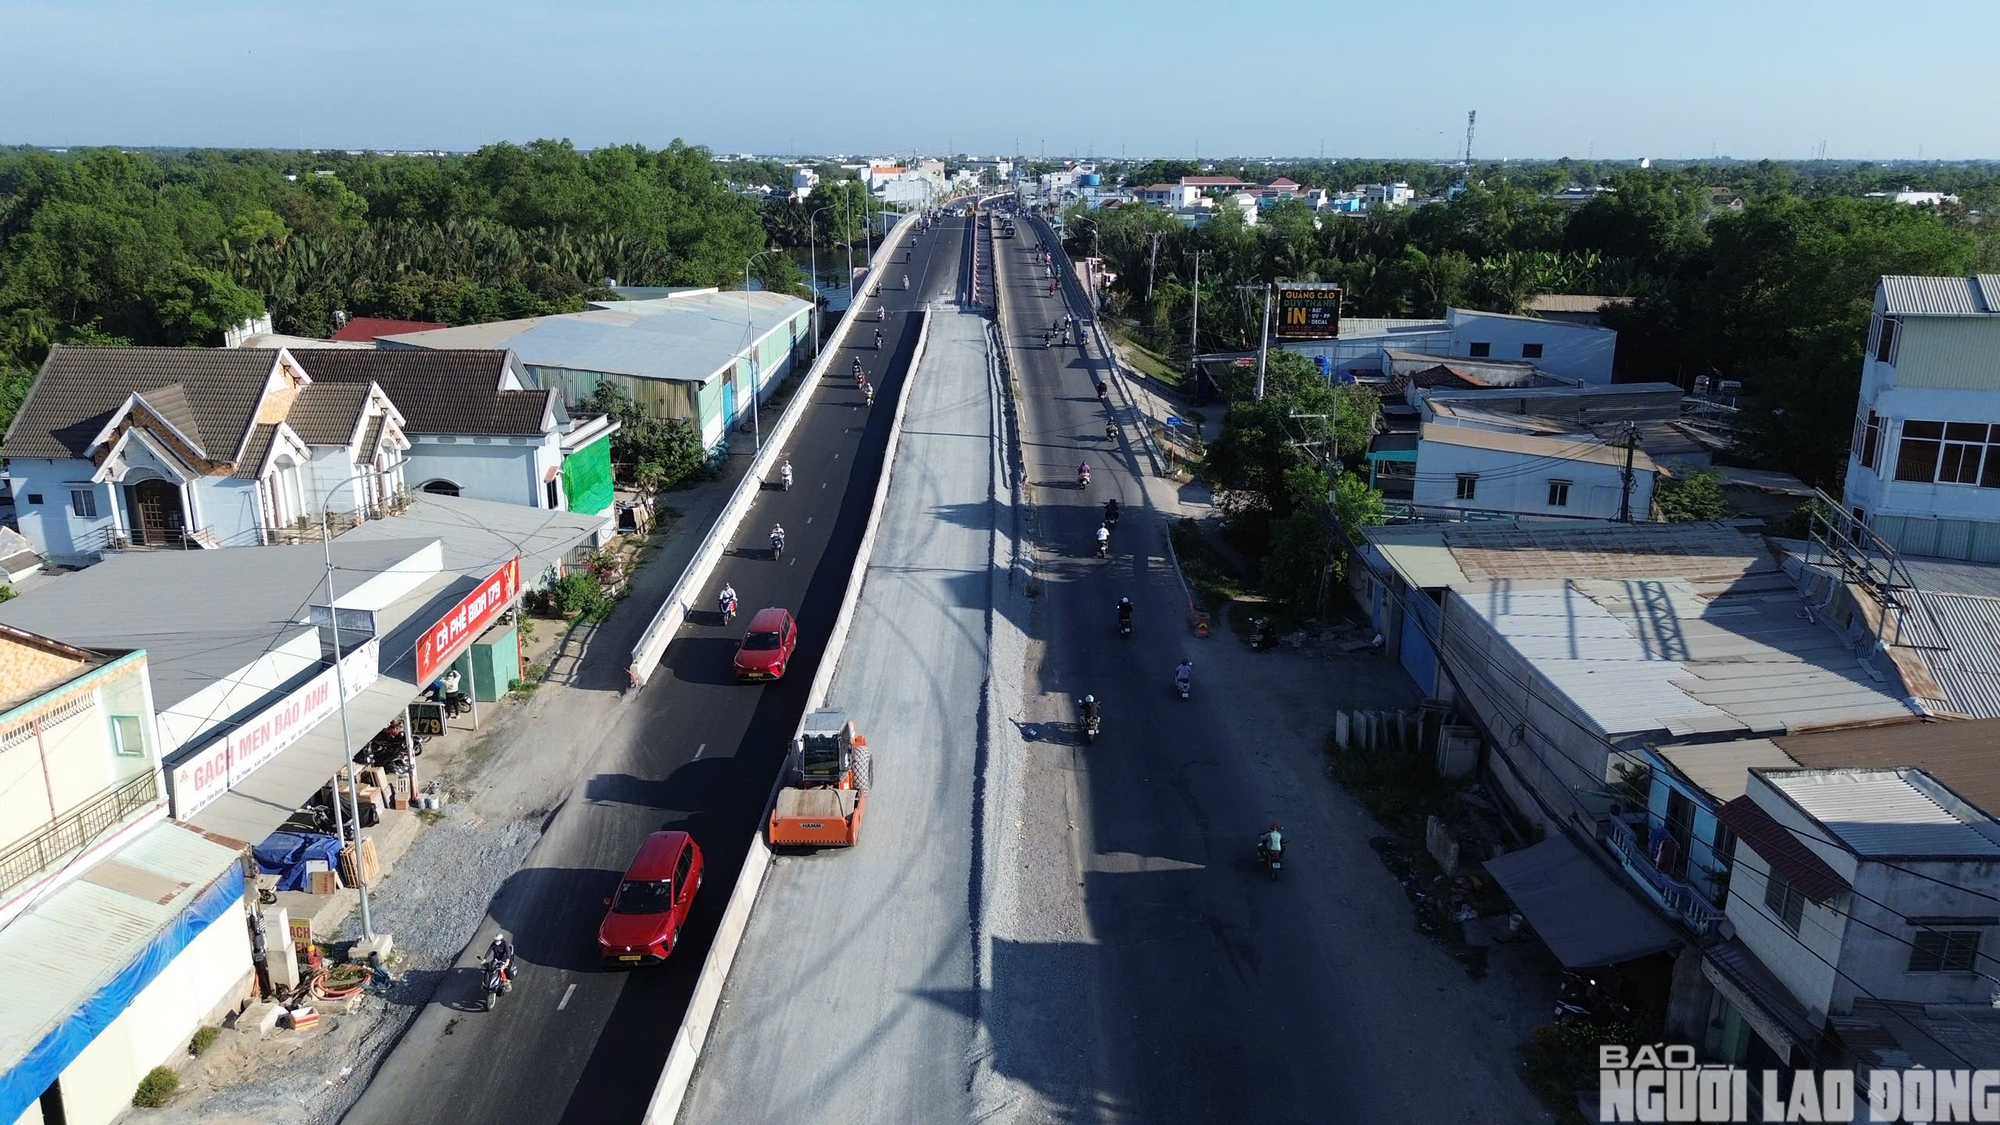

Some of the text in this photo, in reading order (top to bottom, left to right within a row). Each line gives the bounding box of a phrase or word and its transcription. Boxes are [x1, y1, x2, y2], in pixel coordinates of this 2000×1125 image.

[1284, 299, 1302, 307] DUY
[436, 620, 449, 653] CÀ
[450, 604, 467, 640] PHÊ
[467, 591, 487, 624] BIDA
[487, 579, 501, 606] 179
[194, 745, 235, 792] GẠCH
[239, 722, 271, 759] MEN
[274, 700, 300, 735] BẢO
[303, 681, 328, 715] ANH
[412, 718, 441, 734] 179
